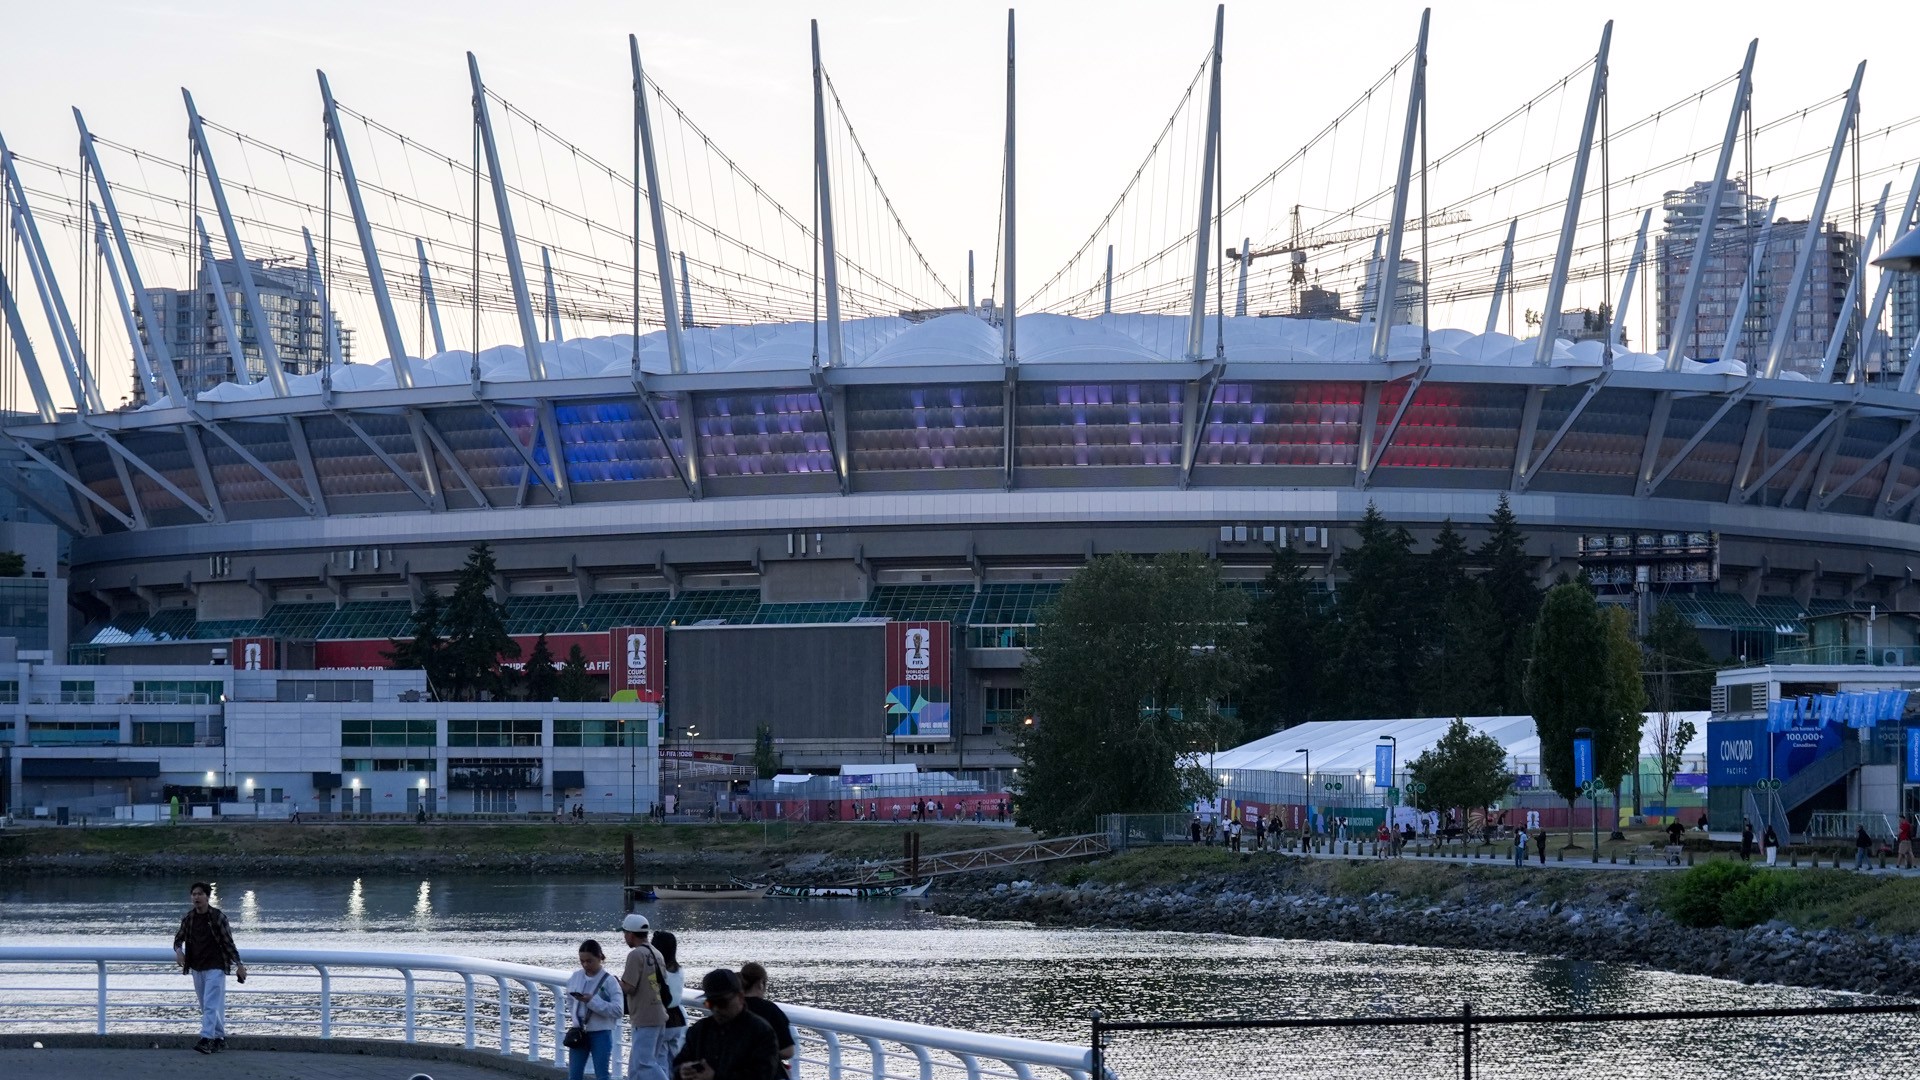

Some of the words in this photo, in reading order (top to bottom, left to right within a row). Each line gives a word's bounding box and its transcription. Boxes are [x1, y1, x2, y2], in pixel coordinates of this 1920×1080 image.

[596, 661, 610, 671] FIF
[1786, 733, 1824, 742] 100,000+
[1726, 767, 1748, 775] PACIFIC
